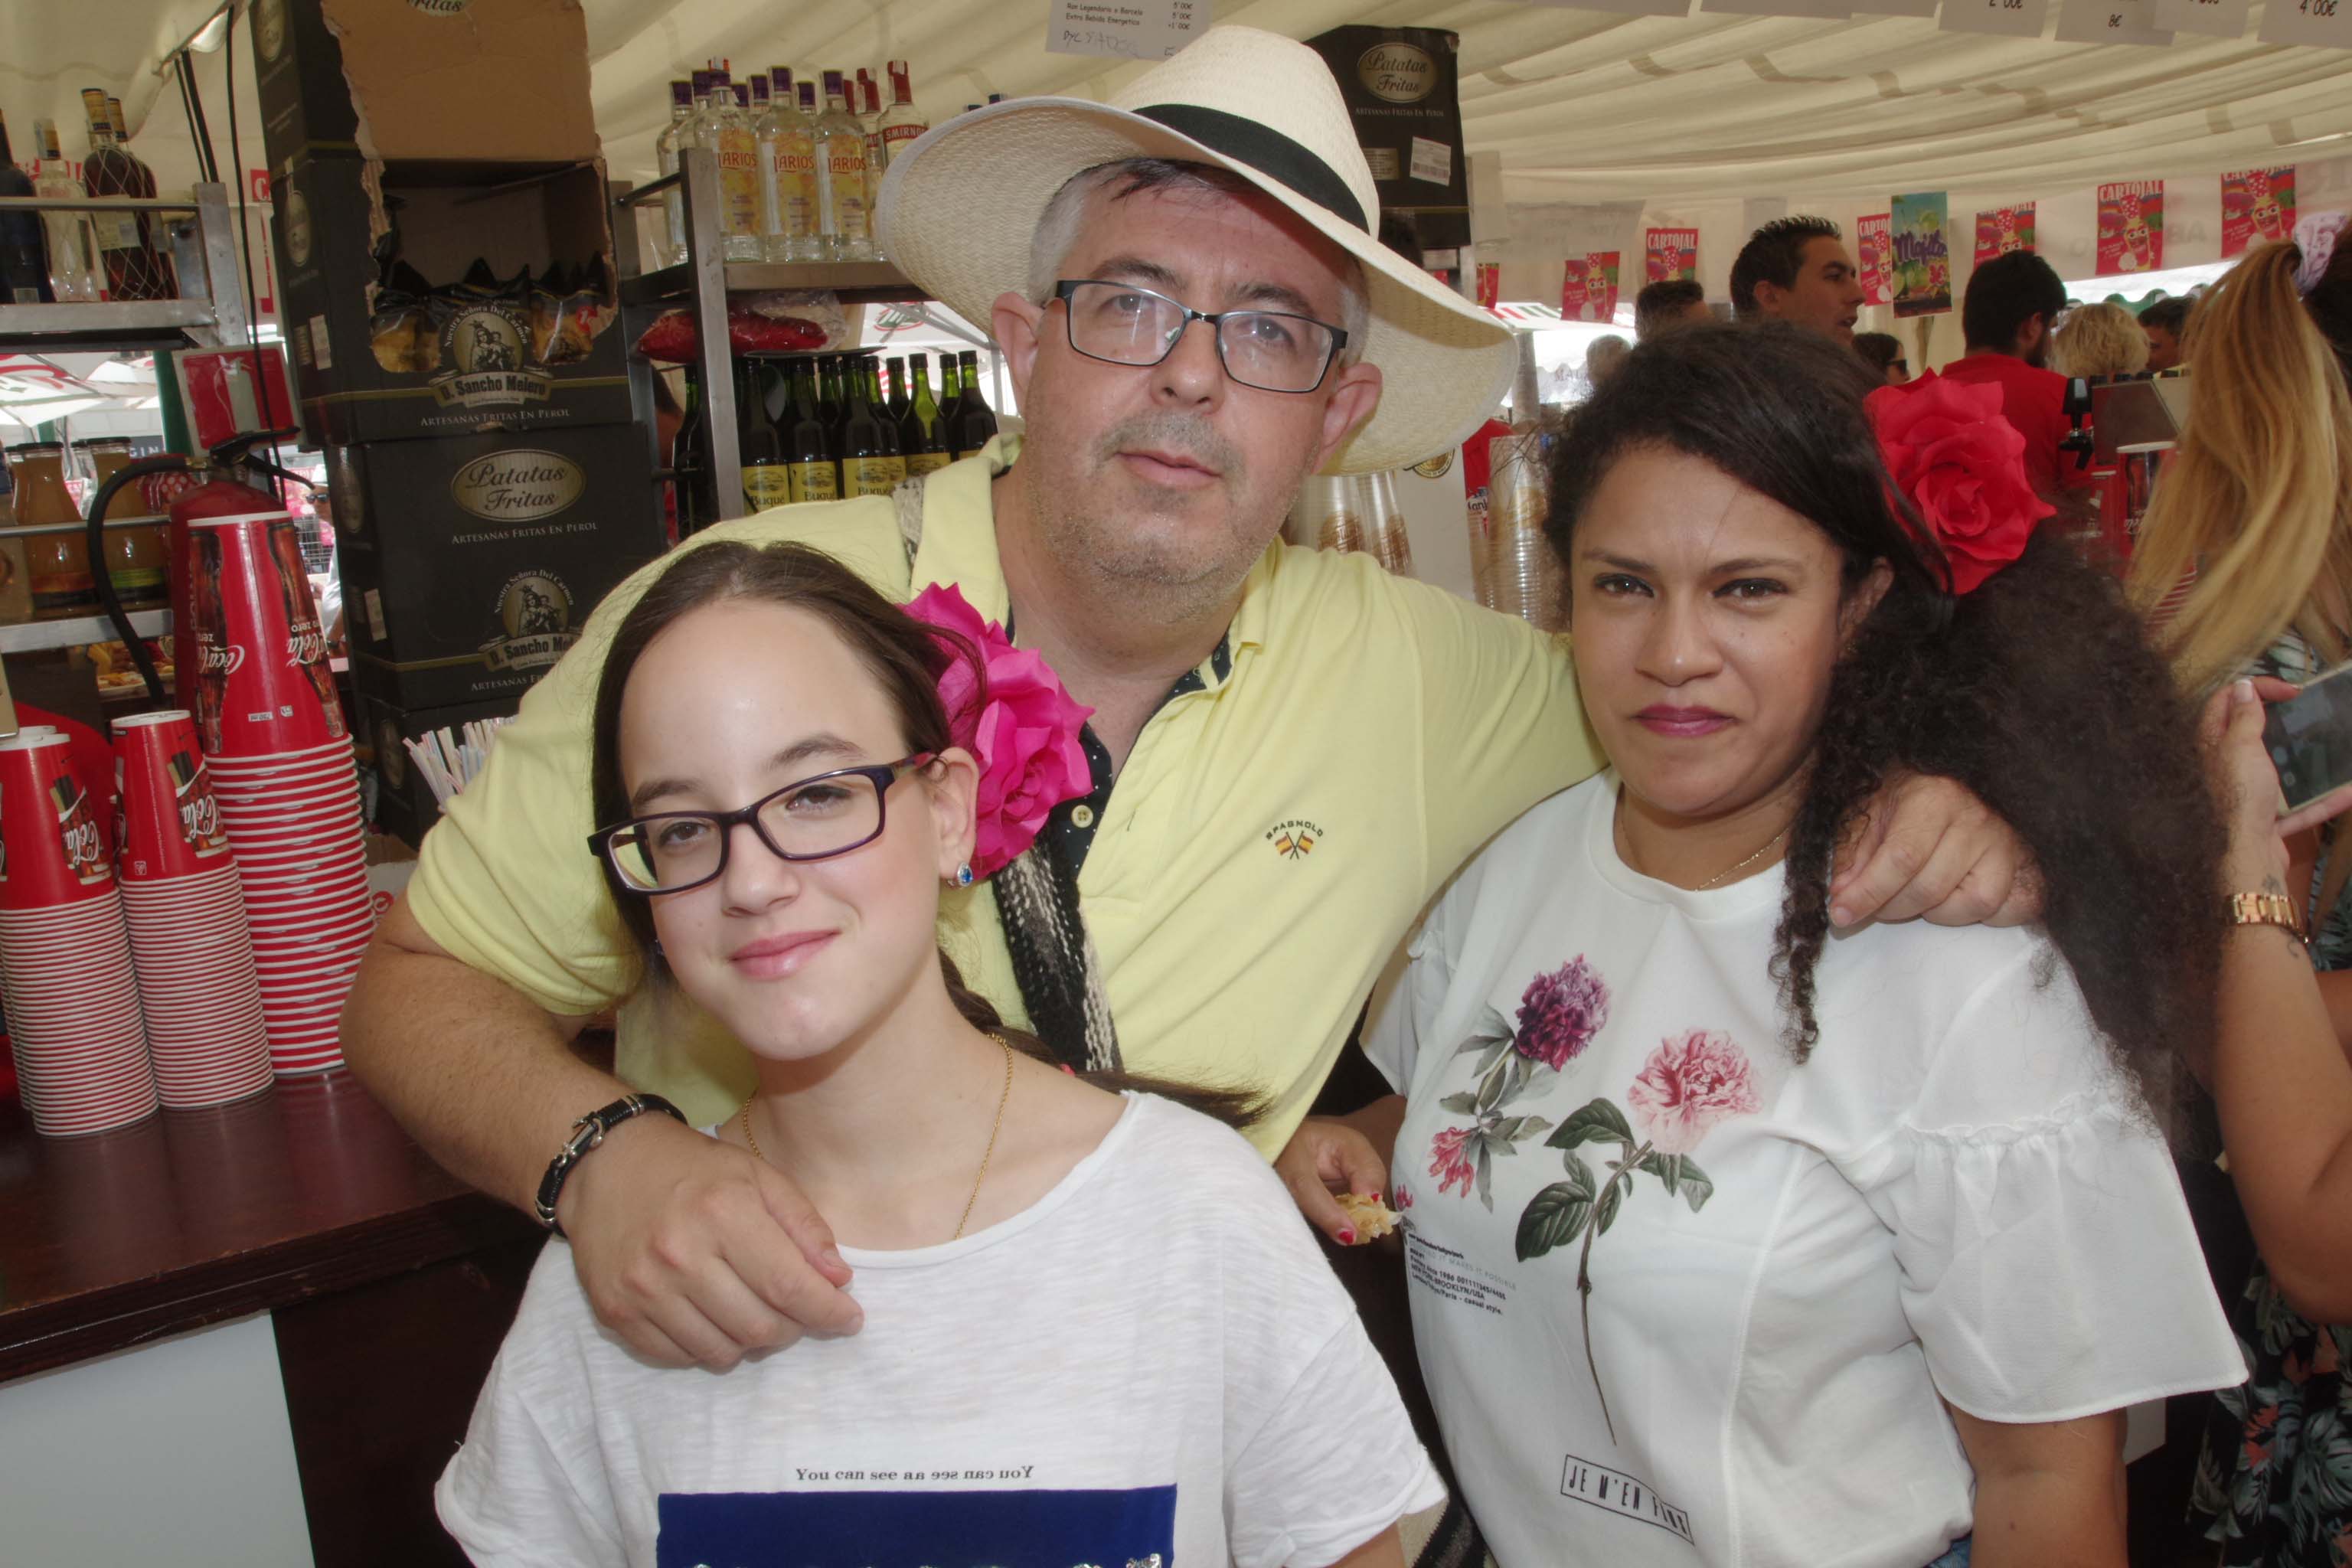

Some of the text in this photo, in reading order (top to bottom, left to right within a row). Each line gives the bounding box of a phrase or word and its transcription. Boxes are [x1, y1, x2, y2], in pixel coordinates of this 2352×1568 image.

[1366, 51, 1428, 74] Patatas
[1378, 74, 1420, 93] Fritas
[717, 152, 758, 170] LARIOS
[773, 155, 815, 173] LARIOS
[828, 157, 867, 175] LARIOS
[455, 374, 503, 396] Sancho
[466, 461, 567, 489] Patatas
[485, 488, 555, 511] Fritas
[504, 639, 550, 660] Sancho
[1439, 1270, 1455, 1282] 1986
[795, 1468, 829, 1481] You
[835, 1469, 865, 1481] can
[870, 1470, 898, 1481] see
[1569, 1465, 1587, 1493] JE
